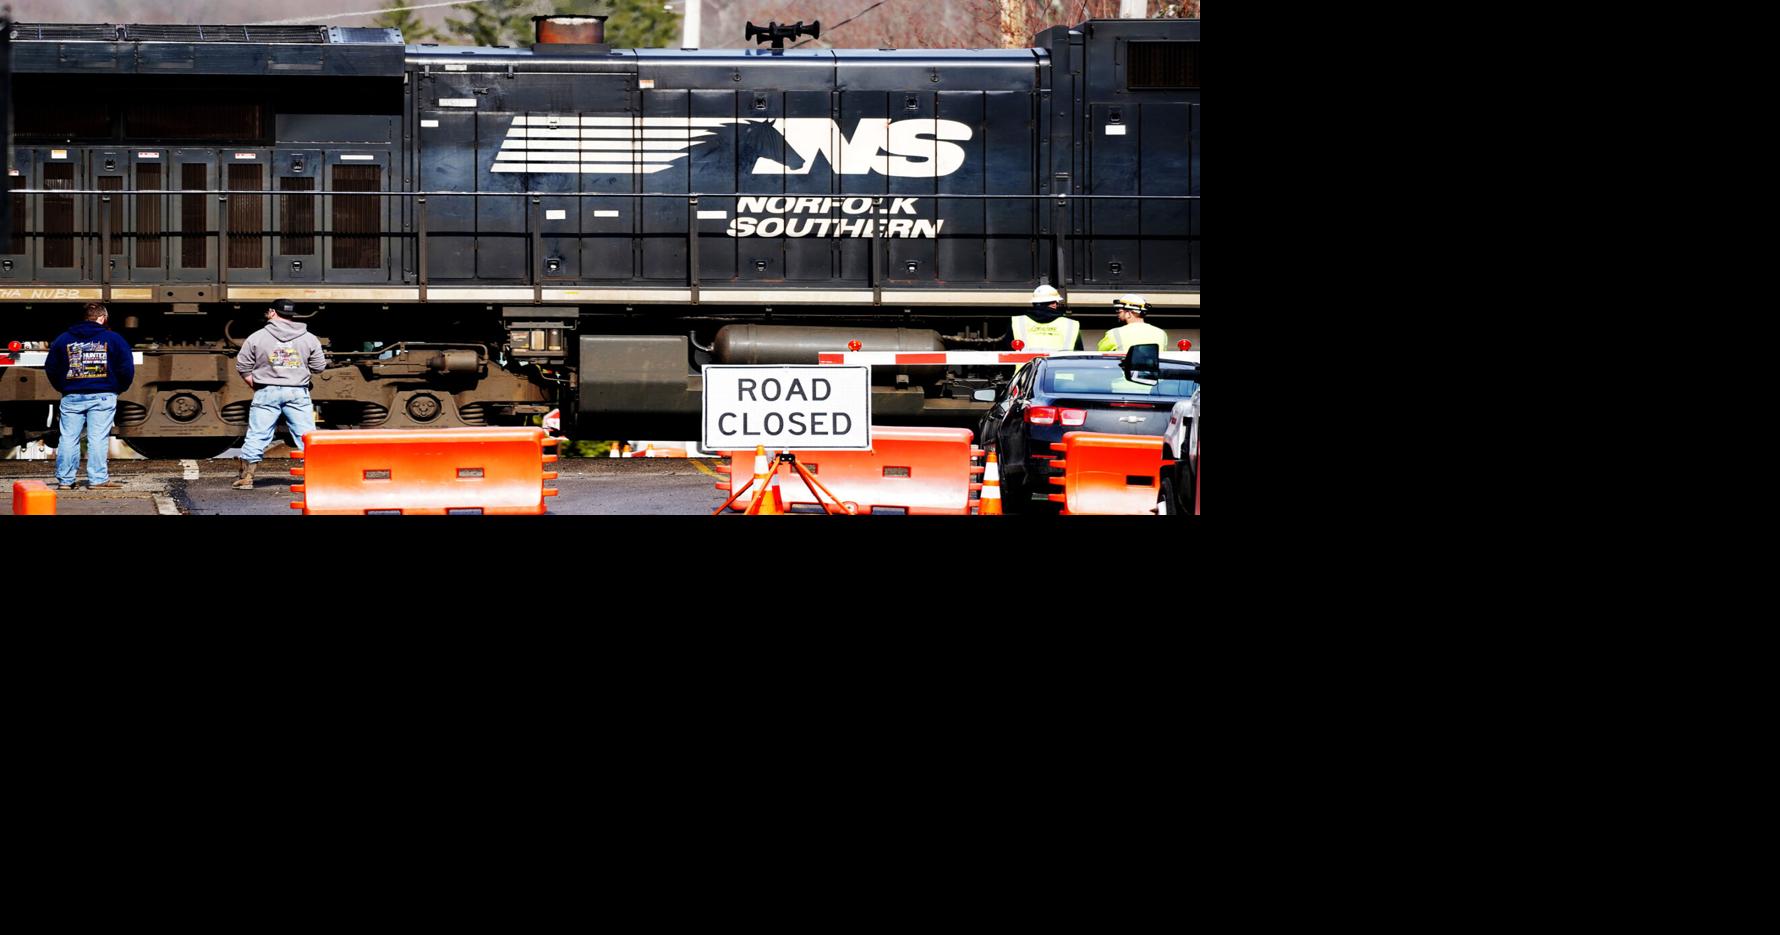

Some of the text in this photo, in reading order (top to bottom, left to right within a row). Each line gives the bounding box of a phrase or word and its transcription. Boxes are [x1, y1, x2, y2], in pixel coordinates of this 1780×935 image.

[751, 117, 973, 177] NS
[726, 217, 945, 239] SOUTHERN
[737, 377, 832, 402] ROAD
[717, 411, 852, 436] CLOSED
